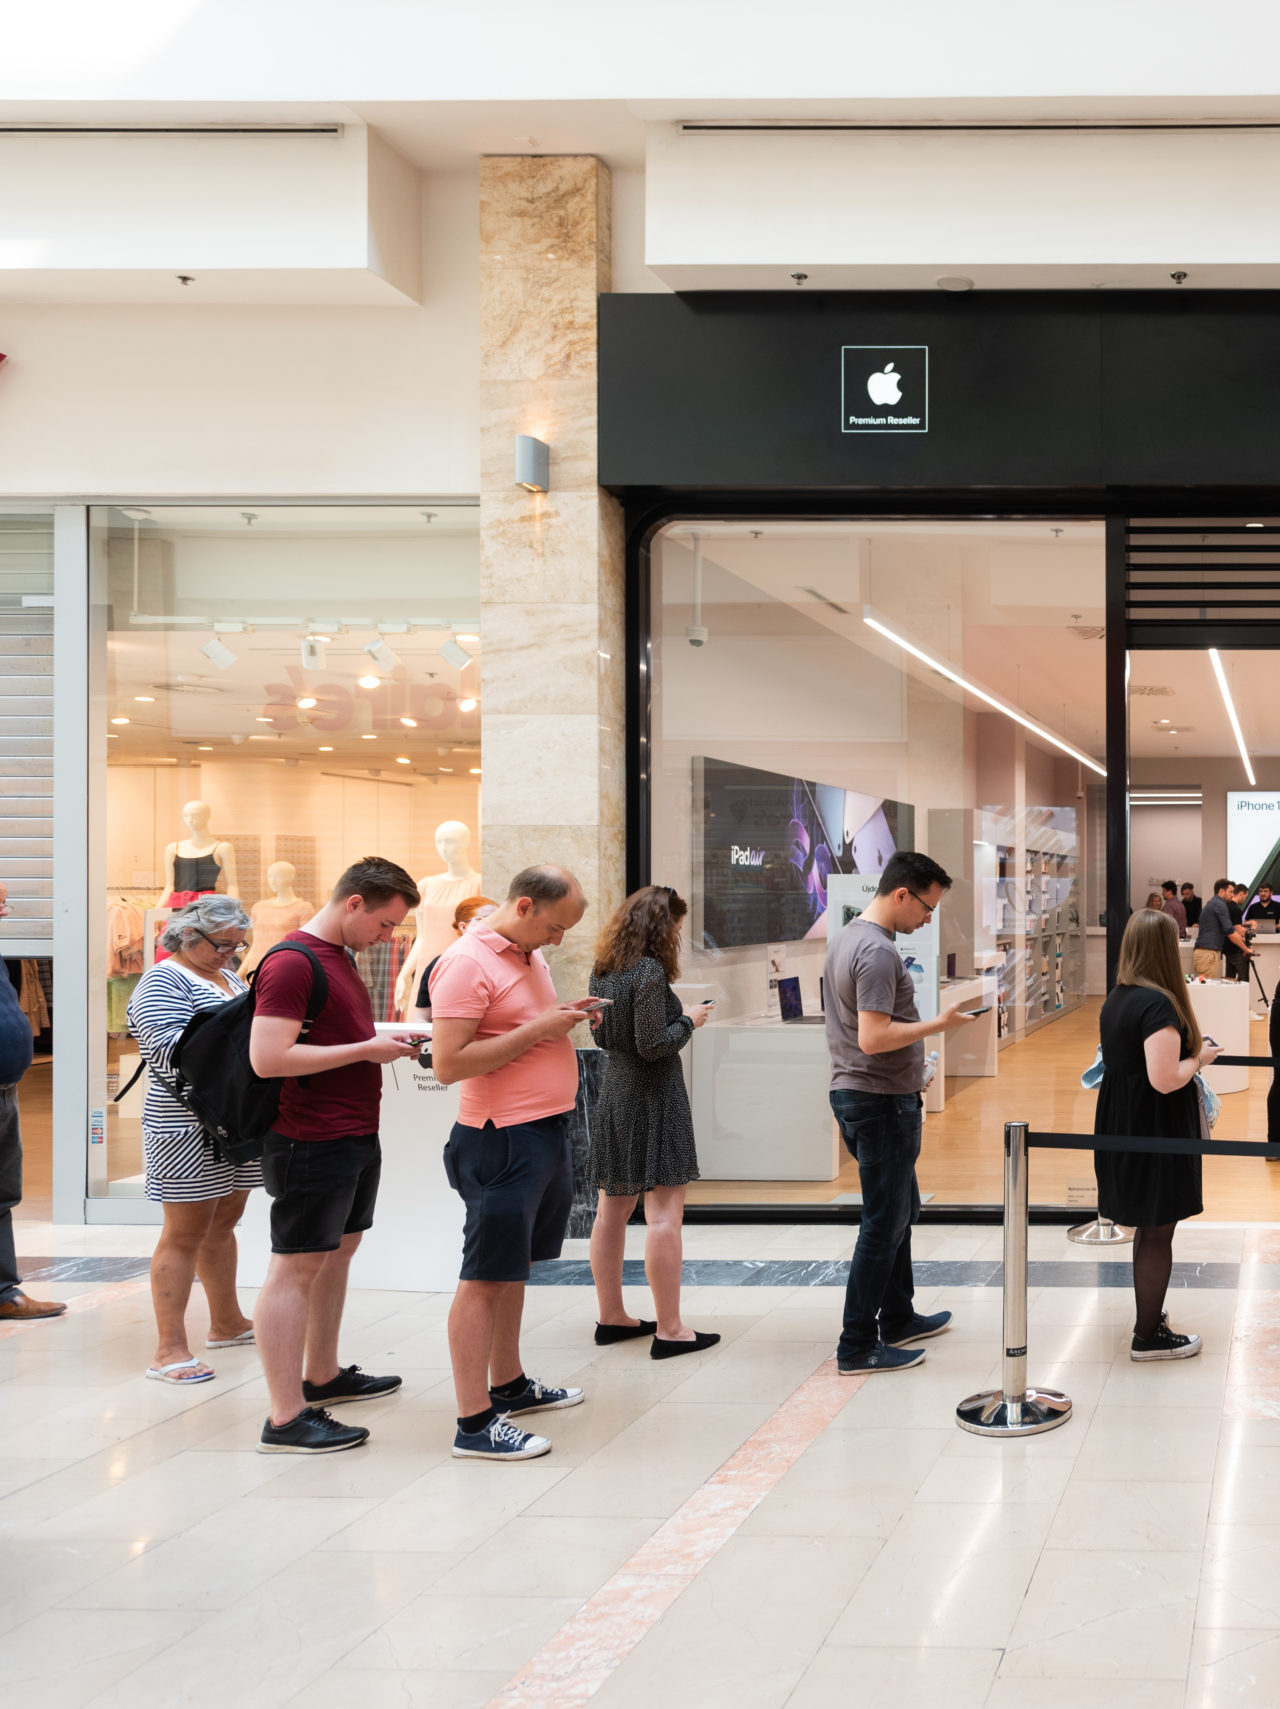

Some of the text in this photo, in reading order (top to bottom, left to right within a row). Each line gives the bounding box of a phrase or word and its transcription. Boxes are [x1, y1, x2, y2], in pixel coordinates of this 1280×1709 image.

[849, 416, 920, 425] Premium Reseller
[1237, 800, 1275, 811] iPhone
[731, 845, 765, 866] iPad air
[861, 882, 879, 894] Újdo
[412, 1073, 437, 1081] Premi
[417, 1083, 449, 1091] Reseller
